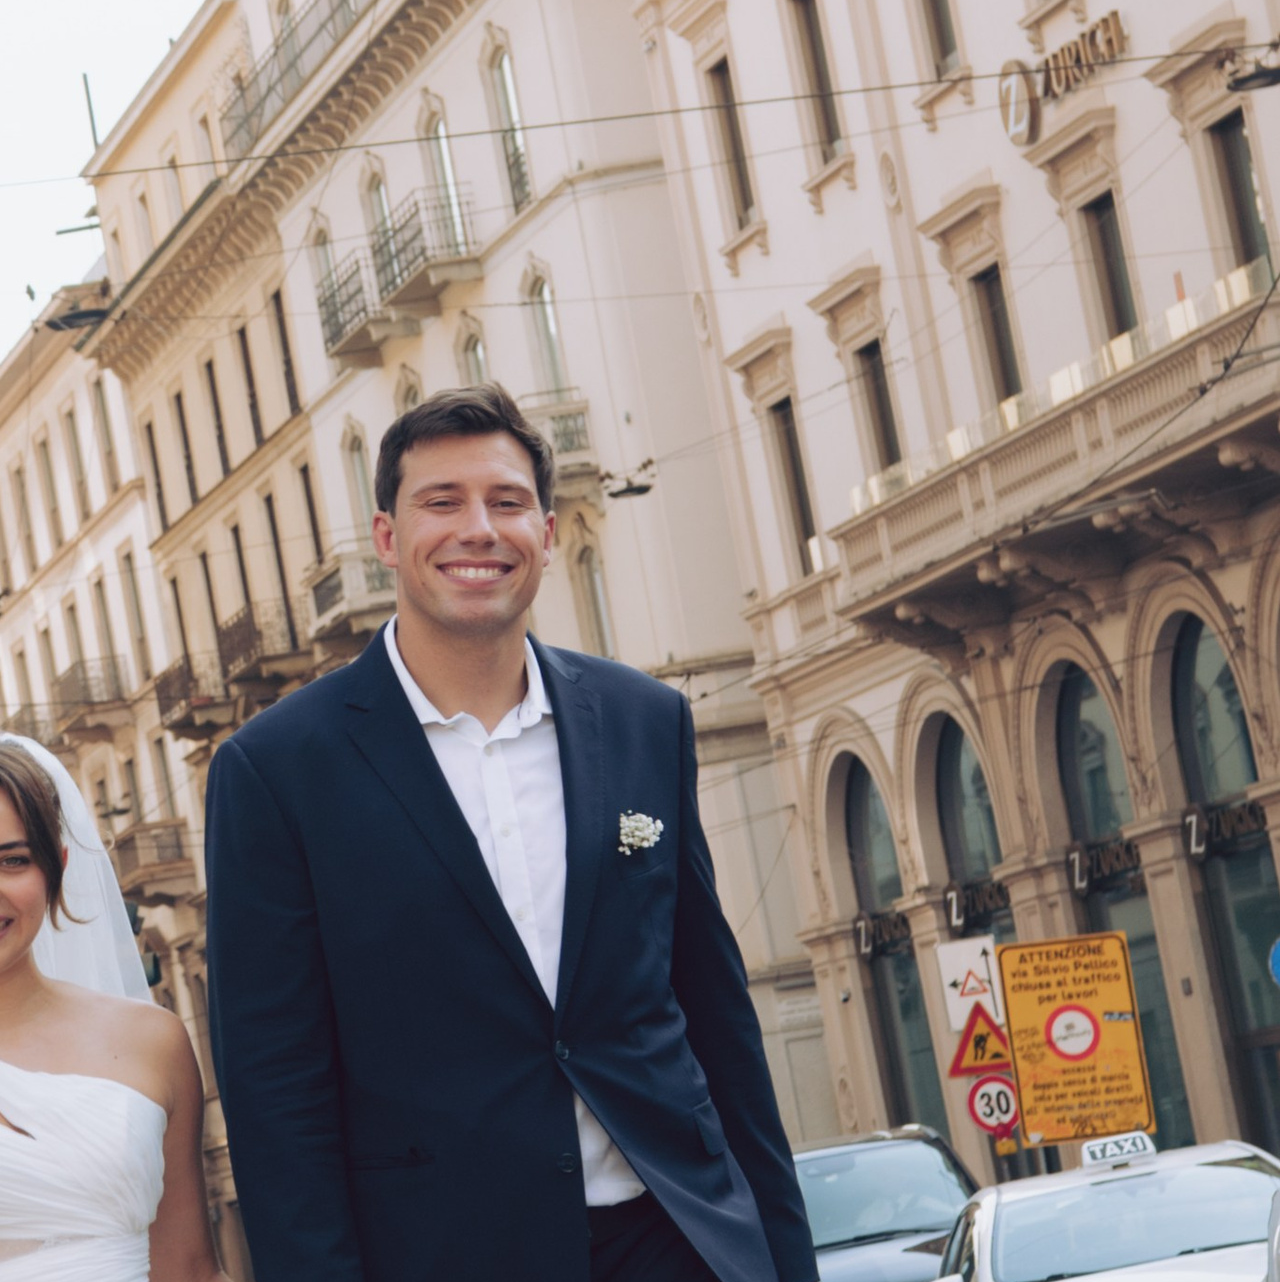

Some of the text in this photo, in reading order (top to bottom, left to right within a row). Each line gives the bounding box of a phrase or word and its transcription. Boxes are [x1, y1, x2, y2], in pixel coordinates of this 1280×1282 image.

[1036, 10, 1125, 99] ZURICH
[1019, 944, 1104, 964] ATTENZIONE
[1011, 959, 1118, 979] via Silvio Pellico
[1011, 973, 1120, 993] chiusa al traffico
[1038, 988, 1098, 1006] per lavori
[980, 1089, 1010, 1118] 30
[1088, 1137, 1144, 1159] TAXI
